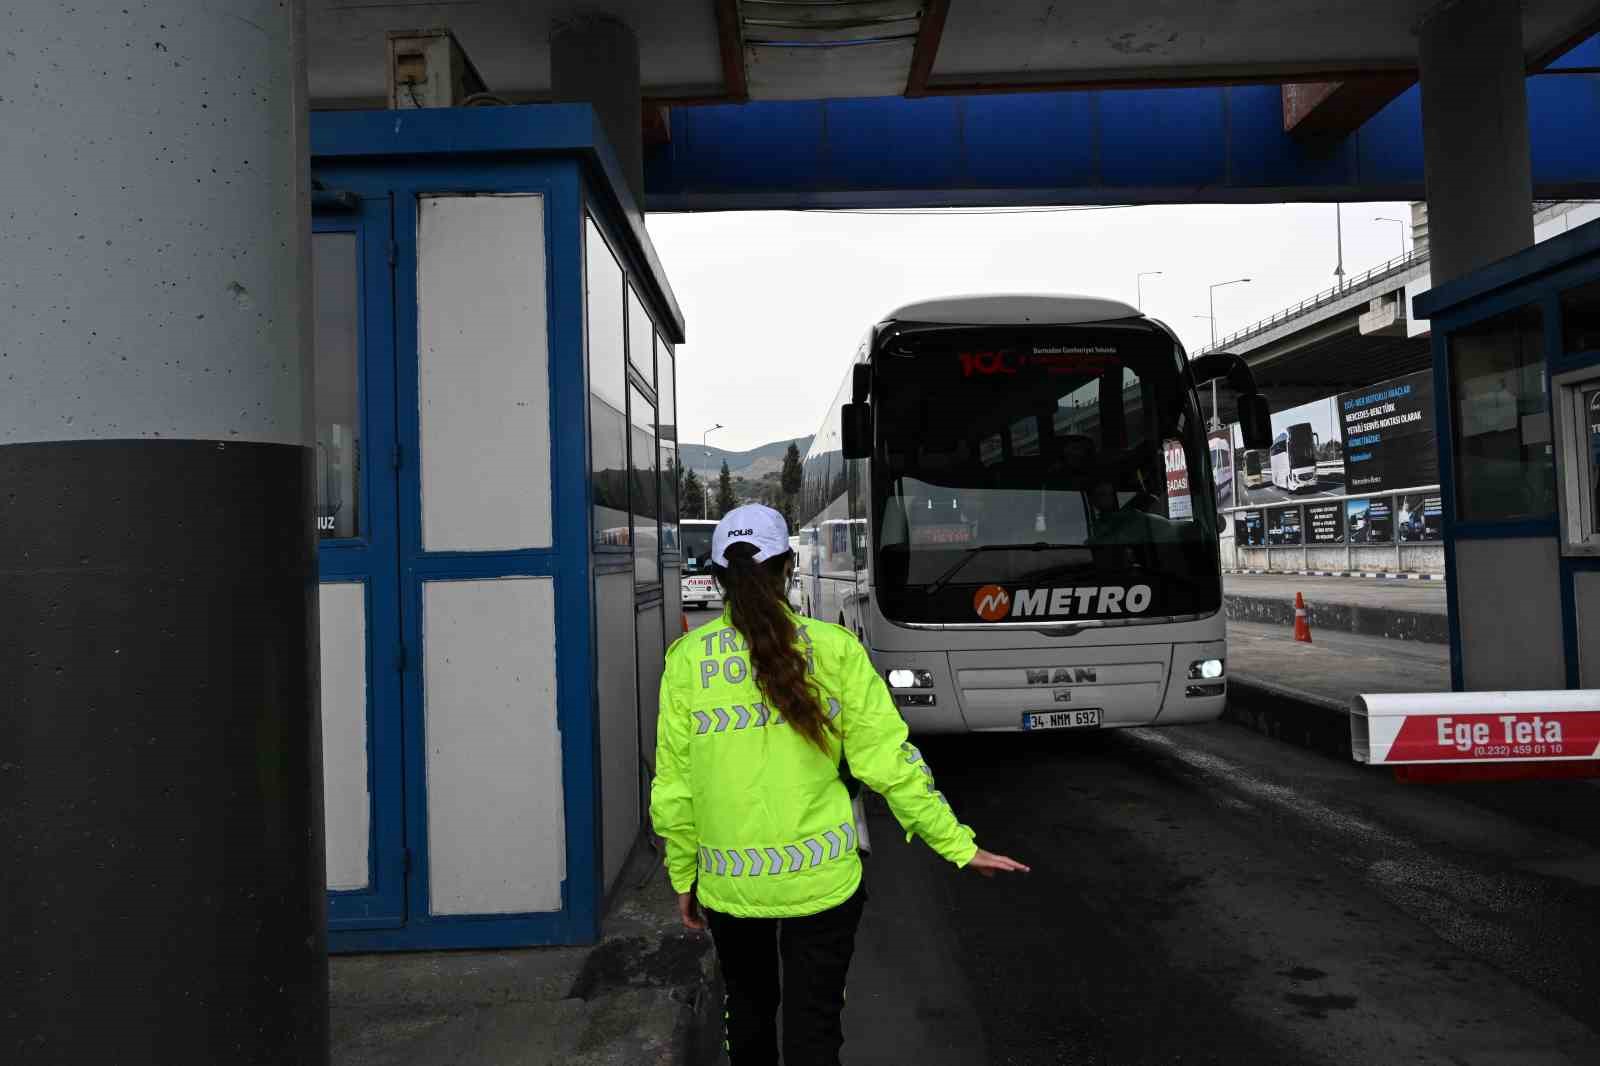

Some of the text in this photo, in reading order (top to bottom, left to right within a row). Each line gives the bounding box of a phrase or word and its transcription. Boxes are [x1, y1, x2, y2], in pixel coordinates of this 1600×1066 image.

[1011, 584, 1151, 617] METRO
[1027, 668, 1096, 684] MAN
[1031, 715, 1044, 728] 34
[1436, 715, 1562, 752] Ege Teta
[1513, 744, 1532, 755] 459
[1534, 744, 1546, 754] 01
[1550, 743, 1562, 754] 10
